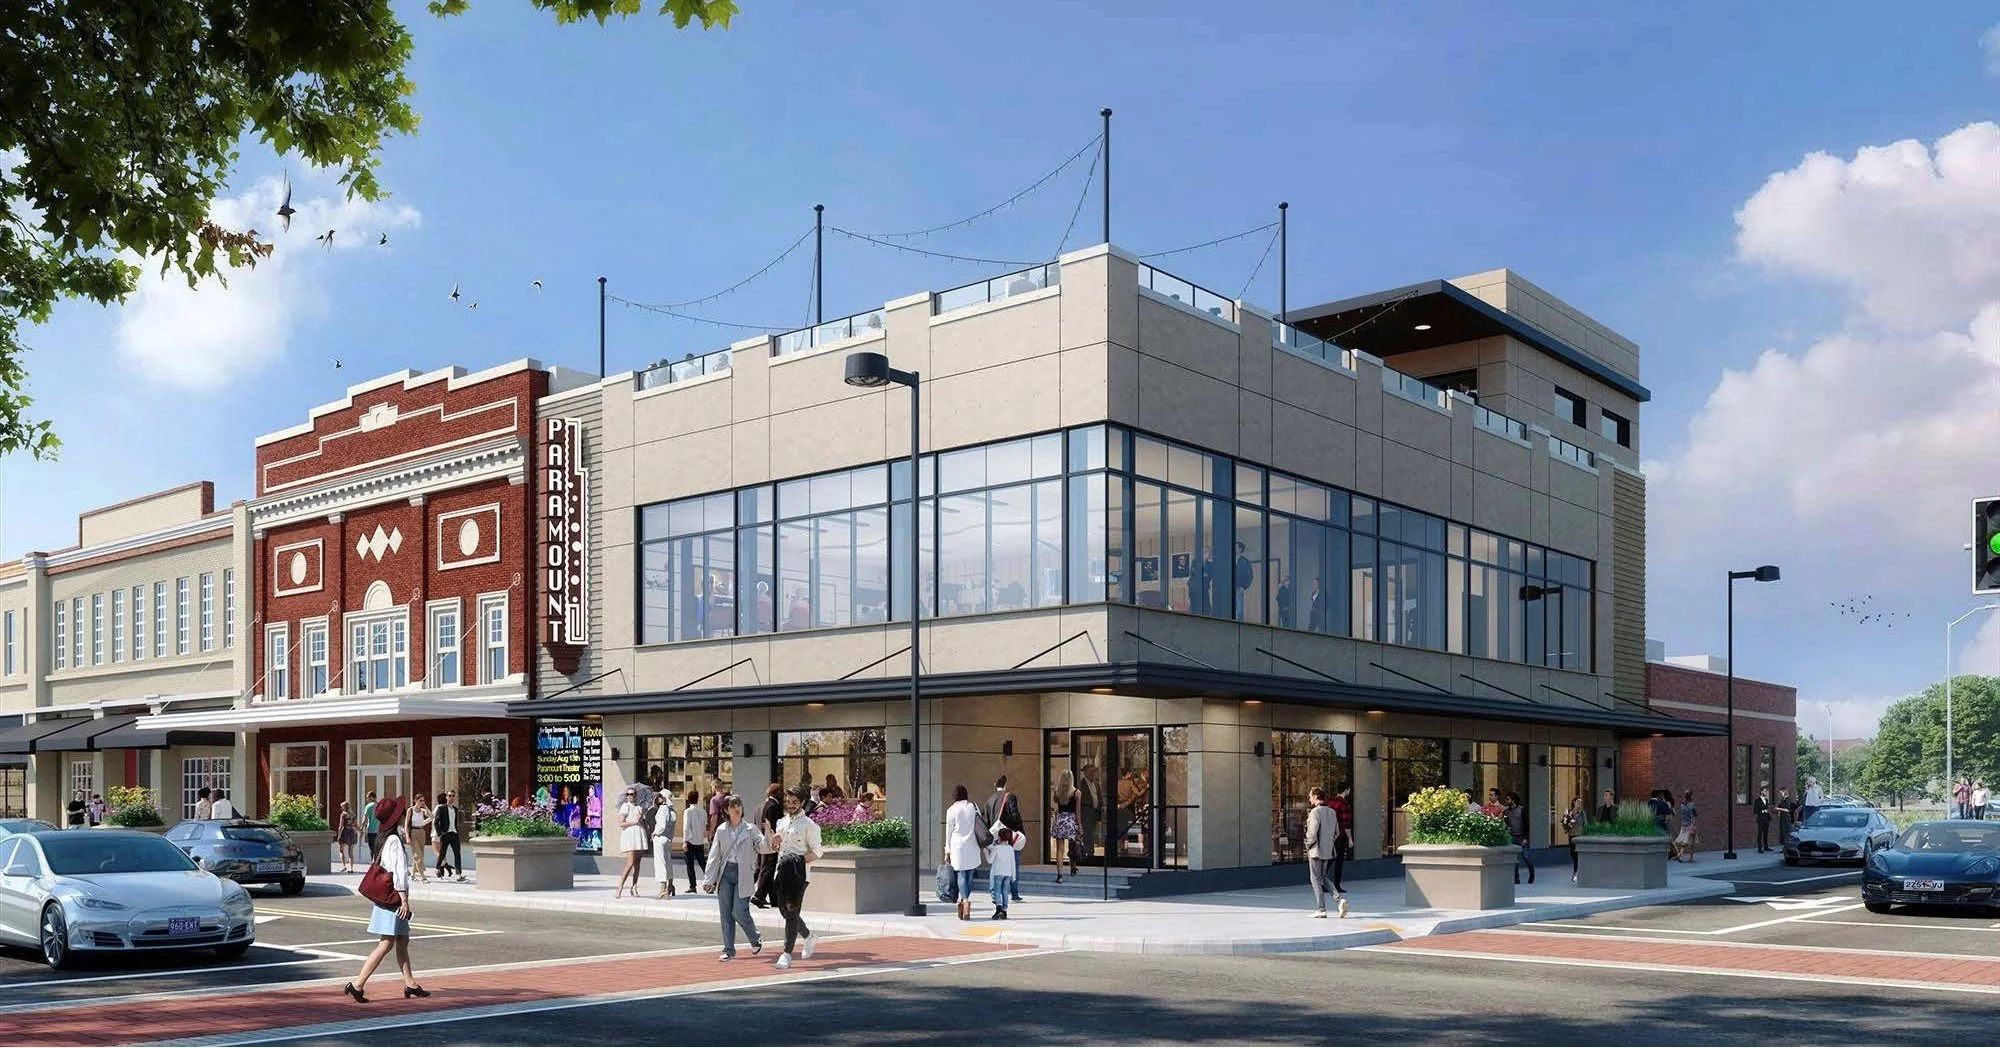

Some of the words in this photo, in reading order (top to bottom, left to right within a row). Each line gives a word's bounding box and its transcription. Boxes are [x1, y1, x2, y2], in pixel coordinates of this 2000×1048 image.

[548, 418, 563, 643] PARAMOUNT
[581, 726, 603, 738] Tribute
[557, 755, 569, 763] Aug
[537, 765, 562, 773] Paramount
[537, 774, 554, 783] 3:00
[554, 774, 563, 783] to
[563, 774, 581, 783] 5:00
